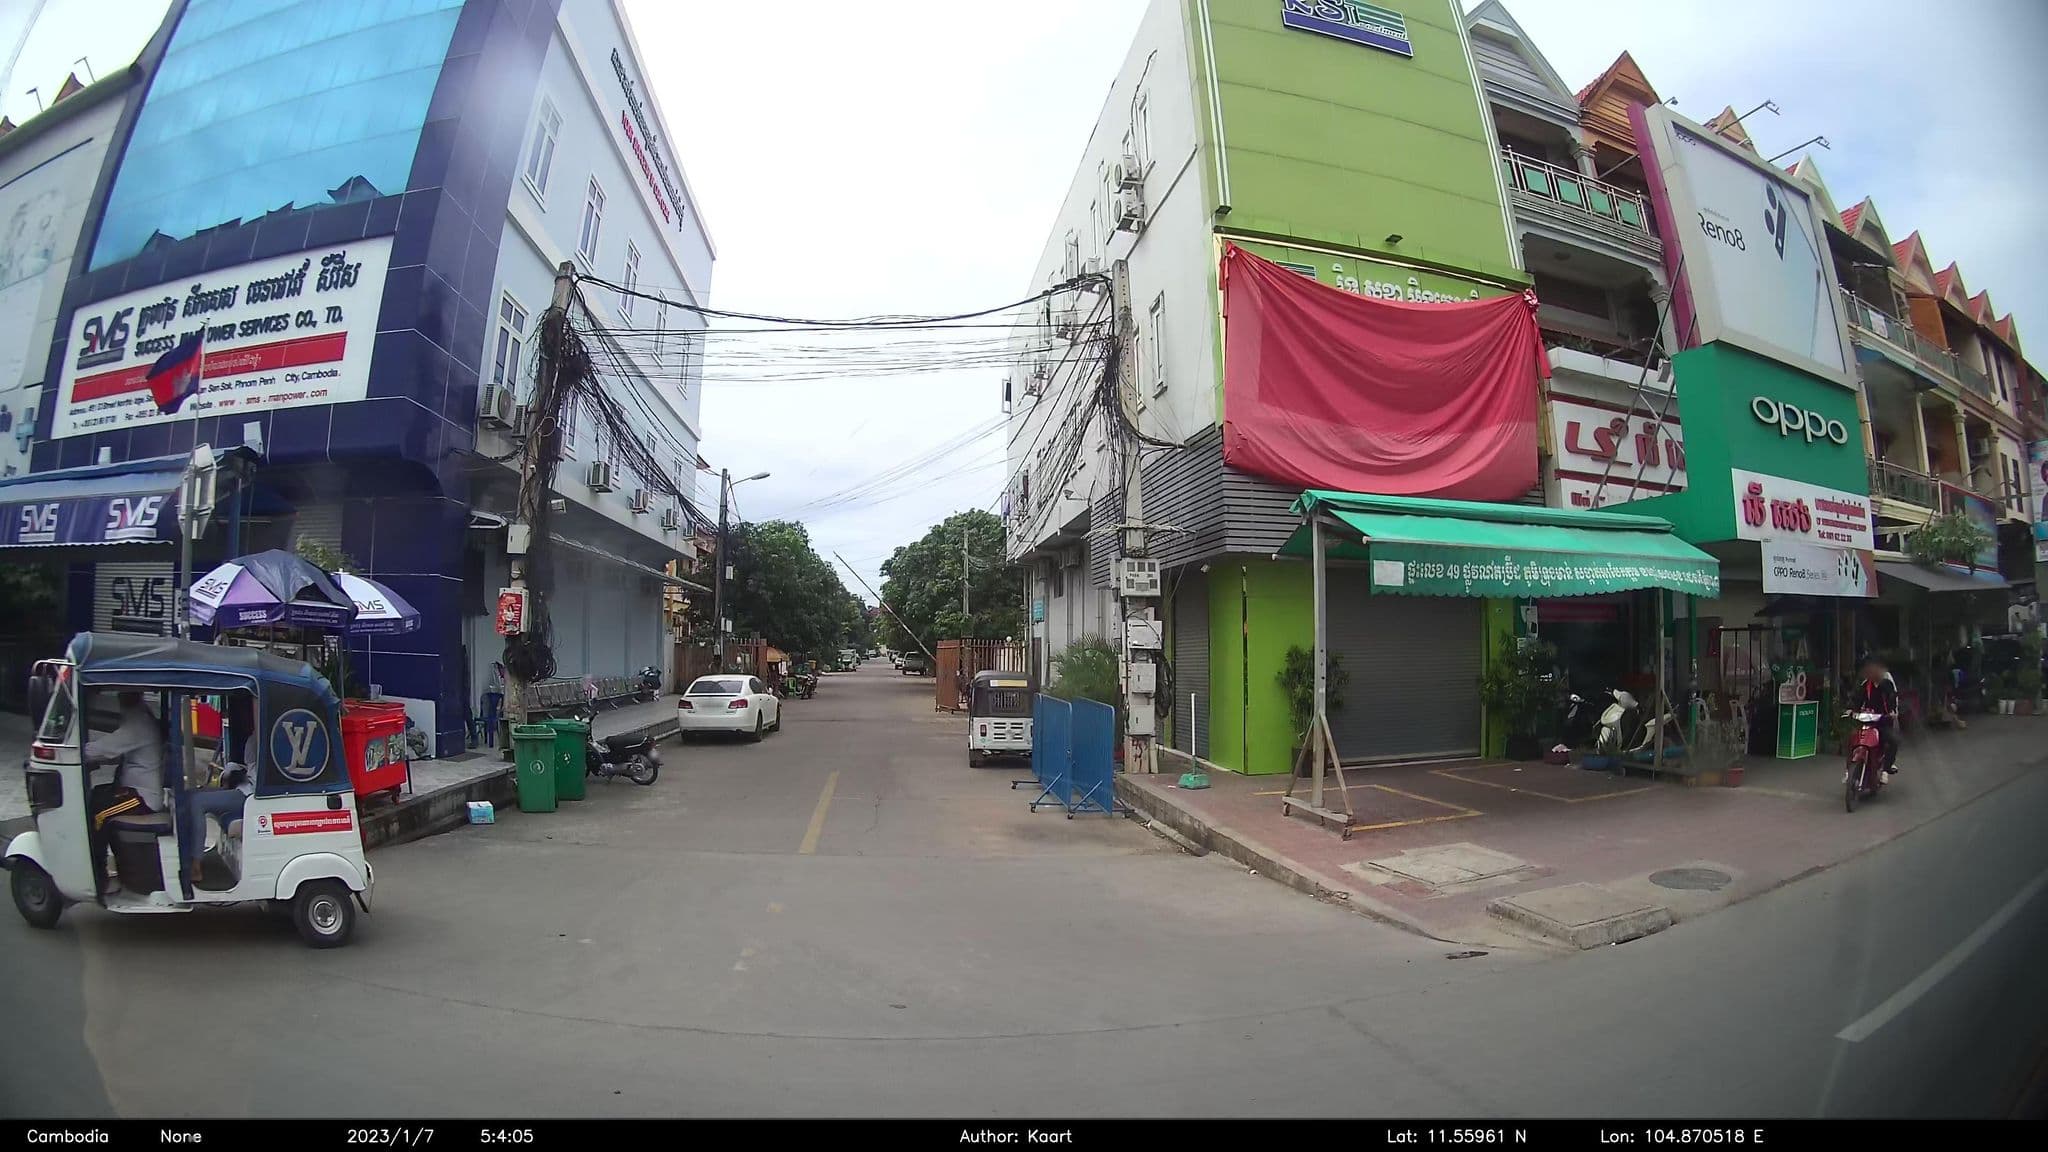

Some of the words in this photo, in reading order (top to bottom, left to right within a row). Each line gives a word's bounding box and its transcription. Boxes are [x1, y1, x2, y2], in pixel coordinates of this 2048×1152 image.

[79, 306, 134, 356] SMS
[135, 335, 176, 356] SUCCESS
[238, 313, 291, 338] SERVICES
[235, 378, 257, 389] Phnom
[259, 376, 276, 386] Penh
[20, 503, 60, 533] SMS
[106, 496, 162, 529] SMS
[200, 578, 229, 595] SMS
[1446, 563, 1460, 580] 49
[111, 577, 165, 618] SMS
[239, 609, 267, 621] SUCCESS
